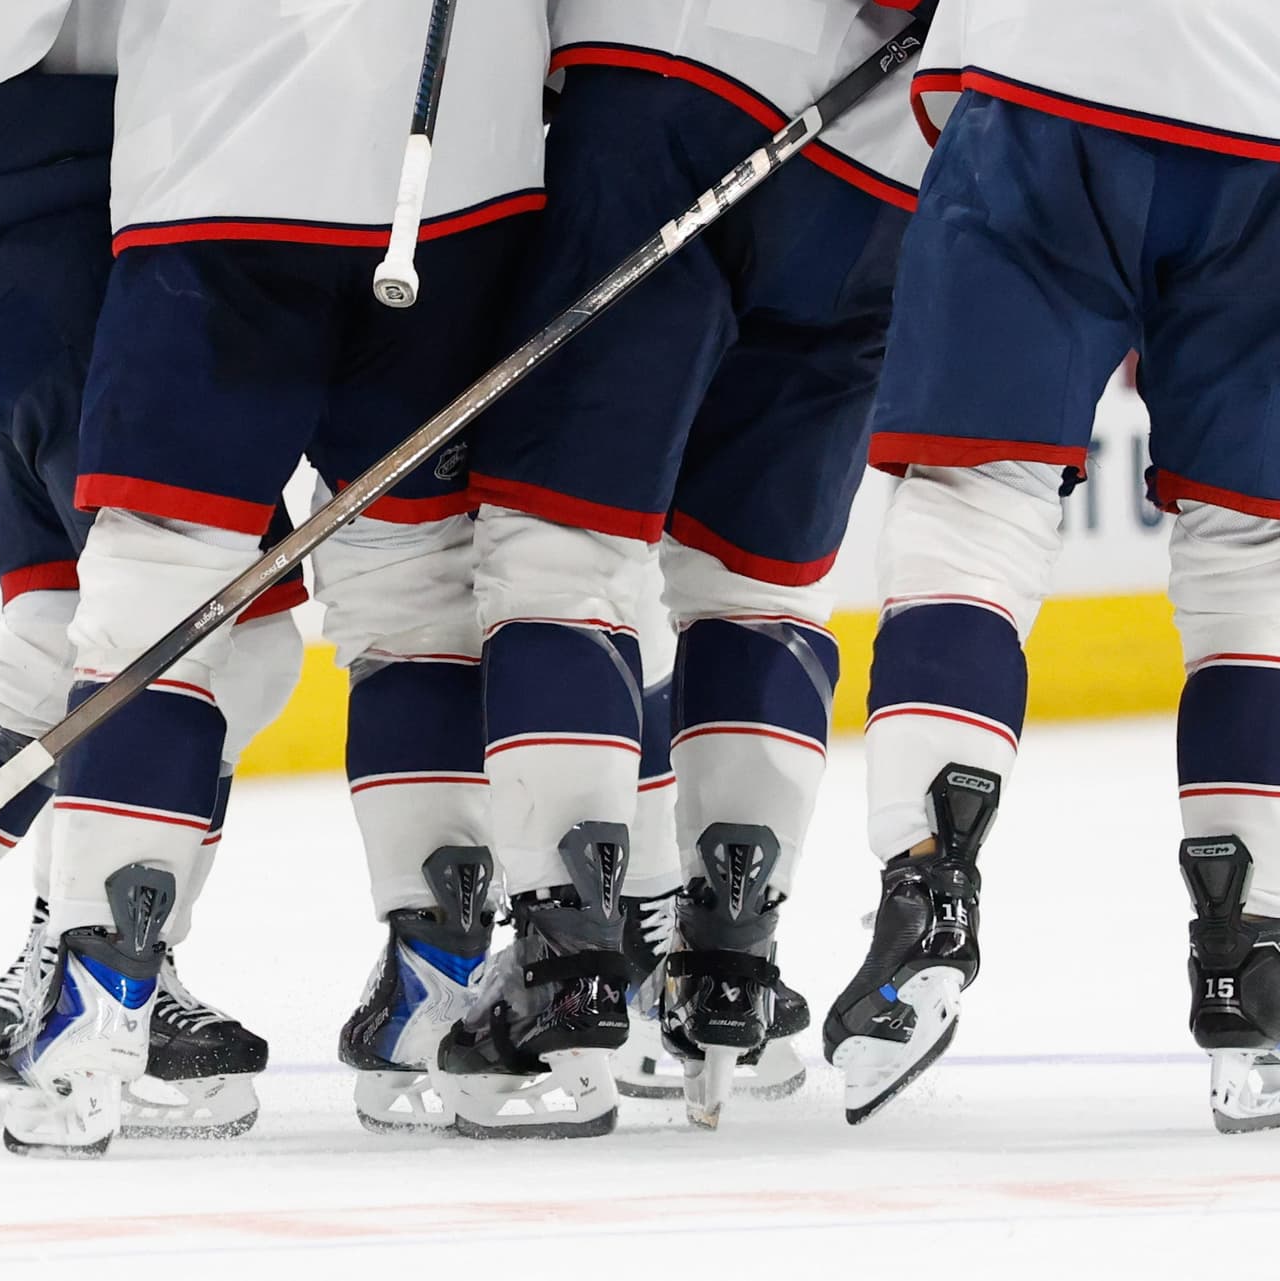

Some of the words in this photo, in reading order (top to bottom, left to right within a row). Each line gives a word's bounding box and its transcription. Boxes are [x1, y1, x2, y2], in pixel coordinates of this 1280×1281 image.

[951, 775, 992, 791] CCM
[1191, 846, 1230, 856] CCM
[1205, 977, 1235, 999] 15
